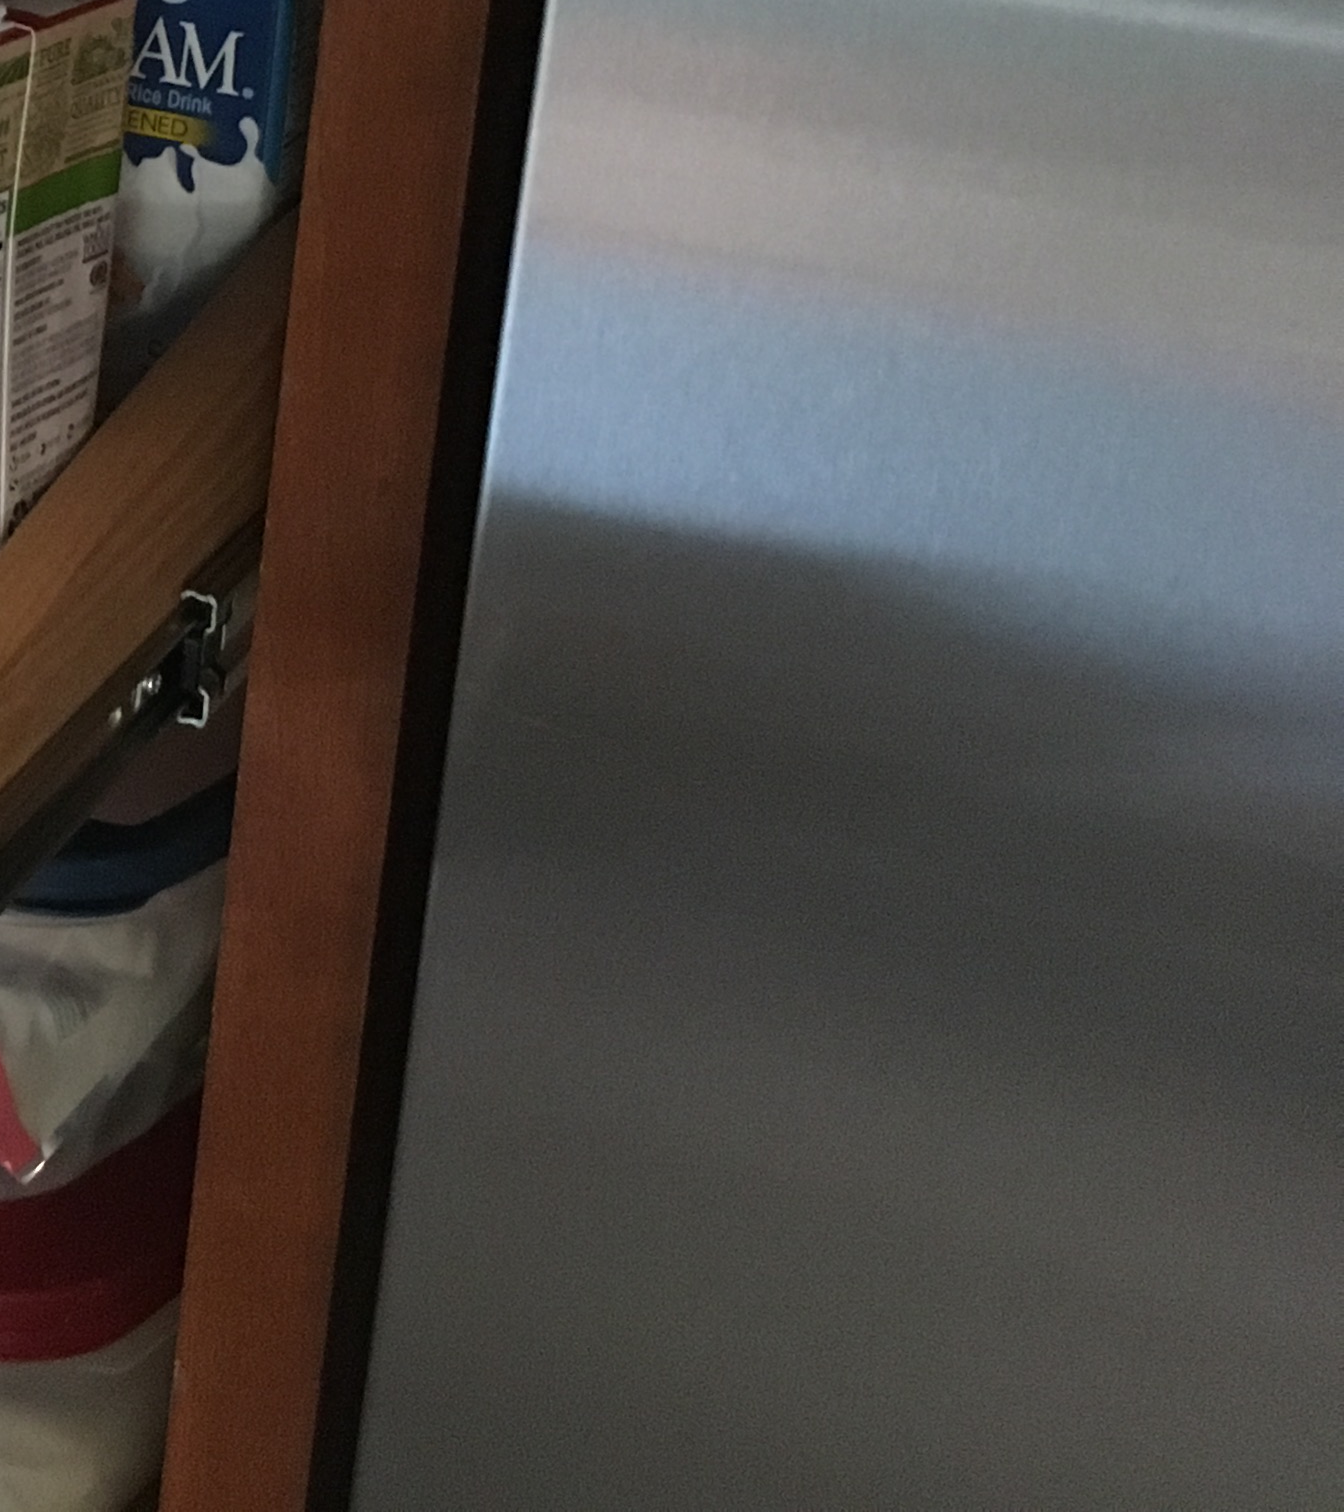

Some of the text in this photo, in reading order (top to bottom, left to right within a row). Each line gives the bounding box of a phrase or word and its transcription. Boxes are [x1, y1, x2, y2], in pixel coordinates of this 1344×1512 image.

[131, 15, 255, 100] AM.
[167, 88, 213, 115] Drink
[127, 112, 189, 139] ENED
